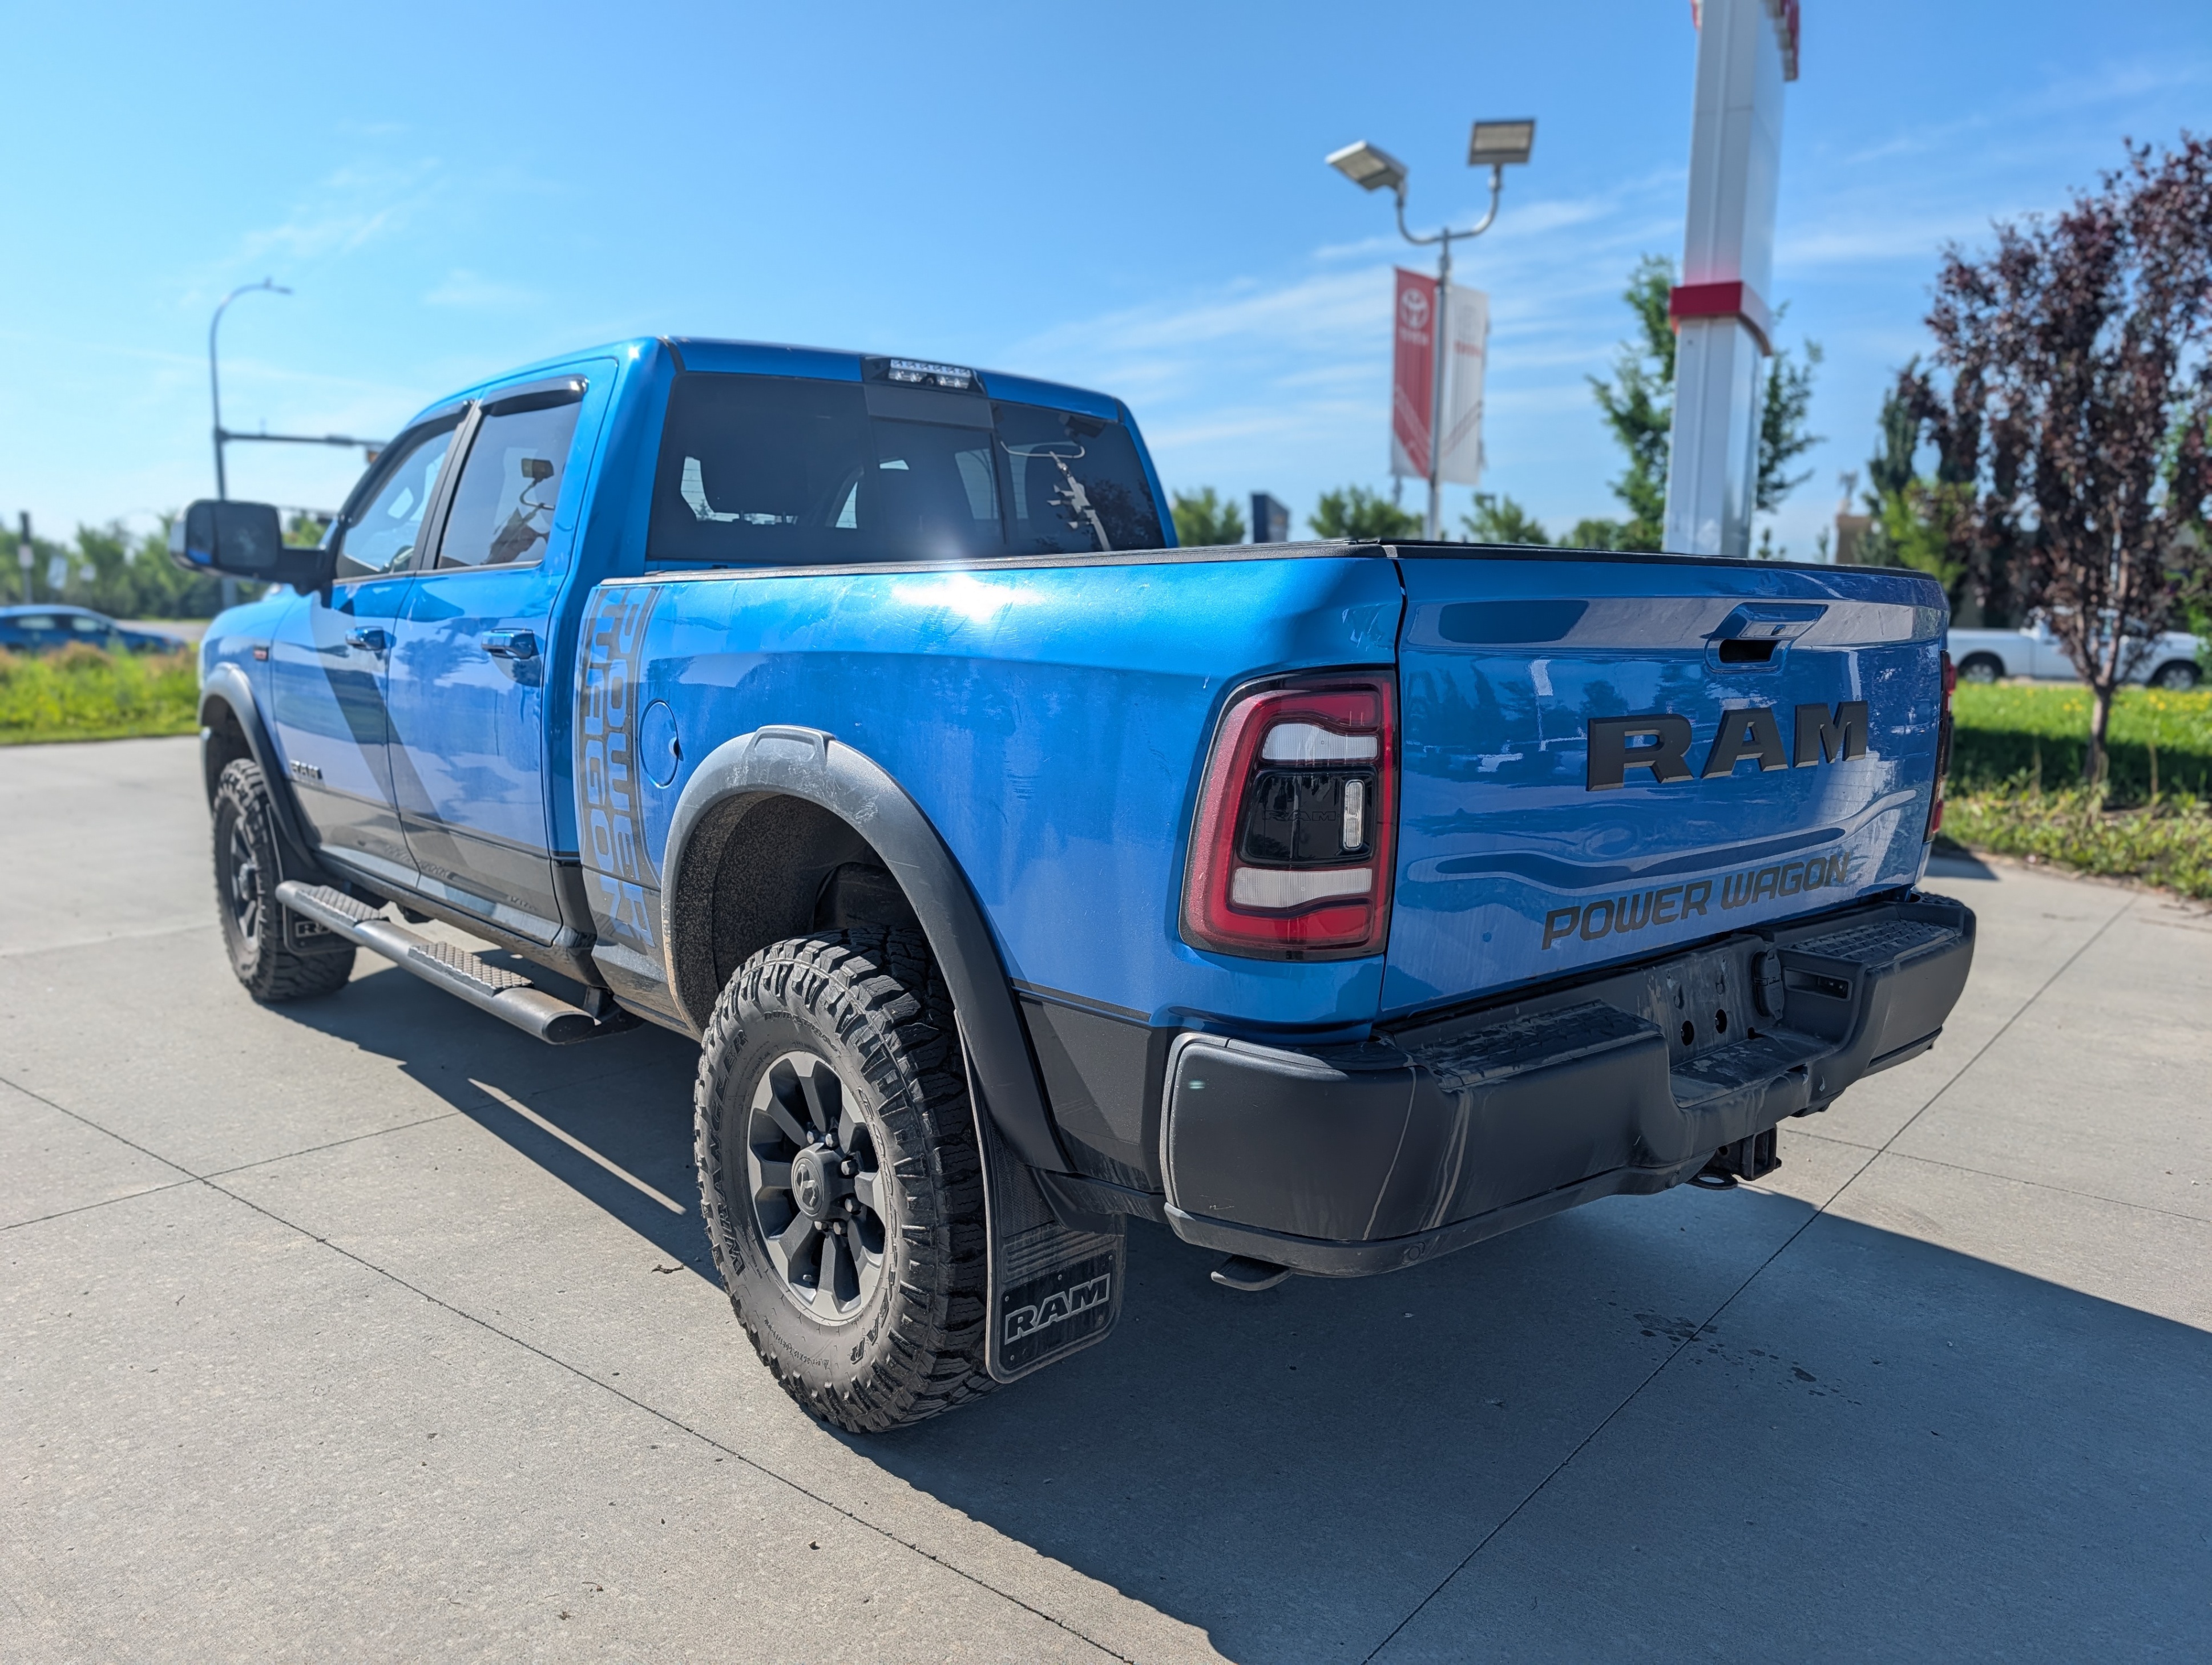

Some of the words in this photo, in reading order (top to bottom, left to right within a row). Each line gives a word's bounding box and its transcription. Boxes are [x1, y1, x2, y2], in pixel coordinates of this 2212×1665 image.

[586, 589, 633, 939] WAGON
[607, 588, 656, 948] POWER
[1588, 701, 1868, 791] RAM
[1541, 880, 1712, 950] POWER
[1721, 853, 1849, 907] WAGON
[711, 1030, 748, 1276] WRANGLER
[1004, 1273, 1110, 1345] RAM
